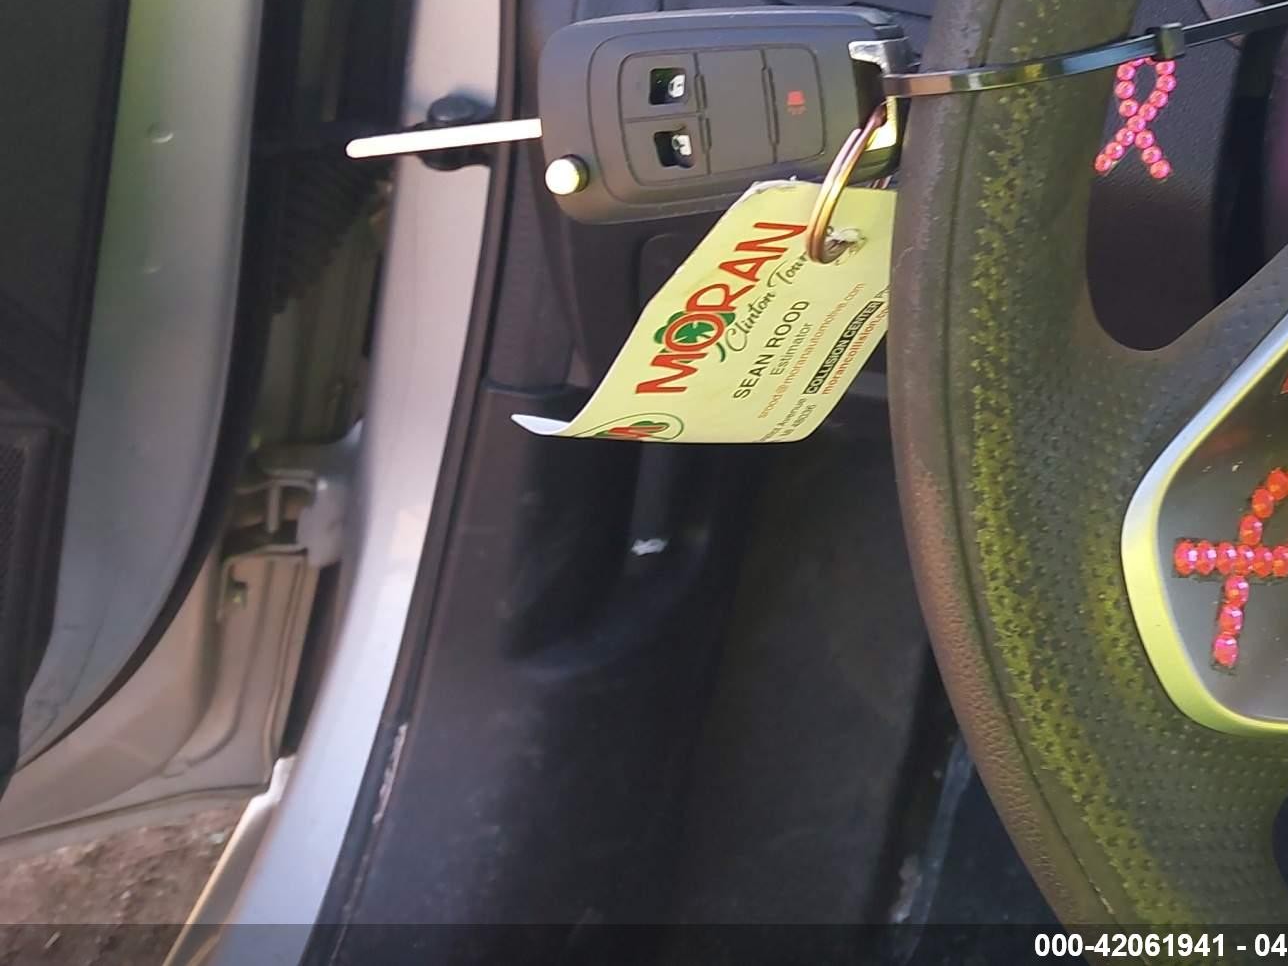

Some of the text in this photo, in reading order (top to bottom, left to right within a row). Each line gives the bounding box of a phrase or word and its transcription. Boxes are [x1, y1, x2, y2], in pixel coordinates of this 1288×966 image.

[635, 221, 809, 395] MORAN
[726, 290, 776, 352] Clinton
[733, 353, 773, 399] SEAN
[766, 300, 811, 349] ROOD
[770, 322, 814, 376] Estimator
[806, 337, 849, 395] COLLISION
[844, 300, 883, 338] CENTER
